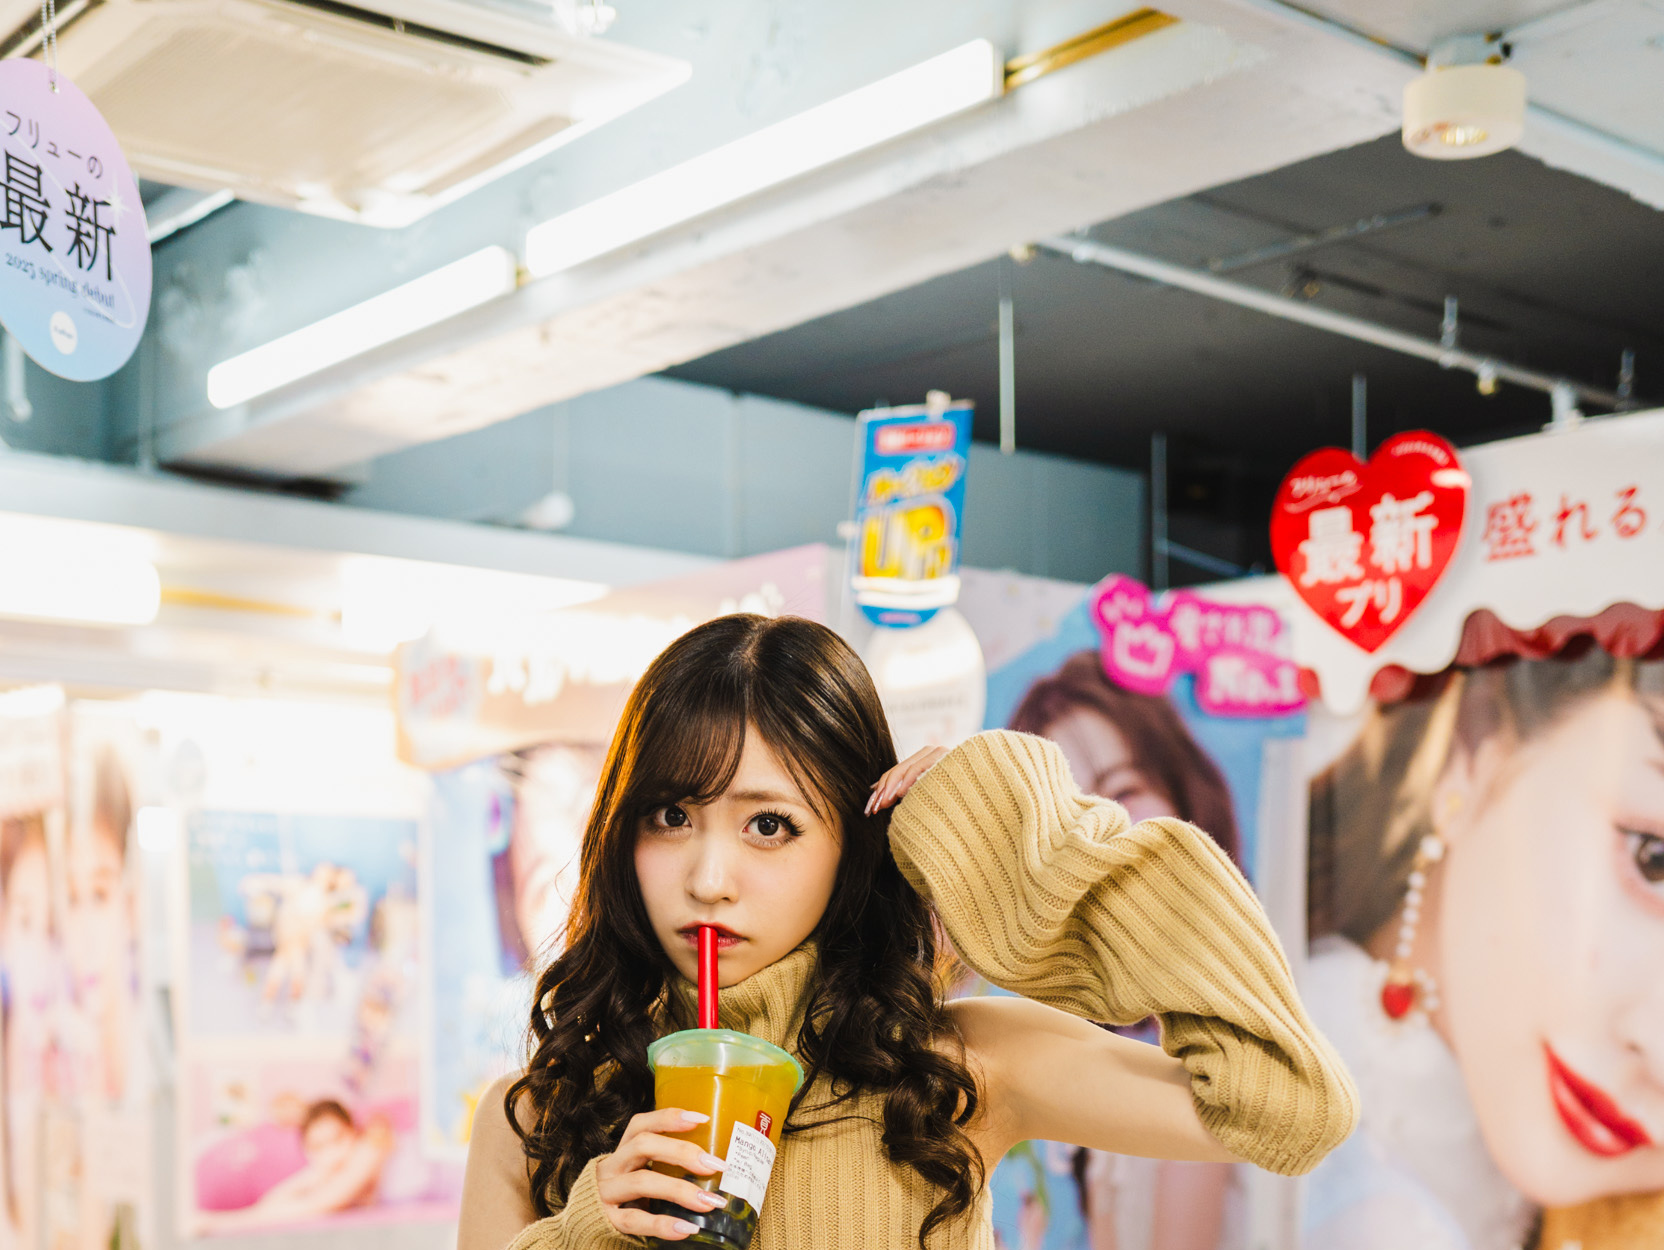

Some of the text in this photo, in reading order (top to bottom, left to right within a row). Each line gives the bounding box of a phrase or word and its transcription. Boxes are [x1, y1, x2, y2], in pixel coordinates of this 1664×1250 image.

[6, 110, 104, 180] フリューの
[0, 149, 117, 282] 最新
[6, 253, 36, 281] 2025
[39, 268, 79, 299] spring
[1297, 489, 1440, 588] 最新
[1334, 576, 1402, 630] プリ
[734, 1135, 757, 1152] Mango
